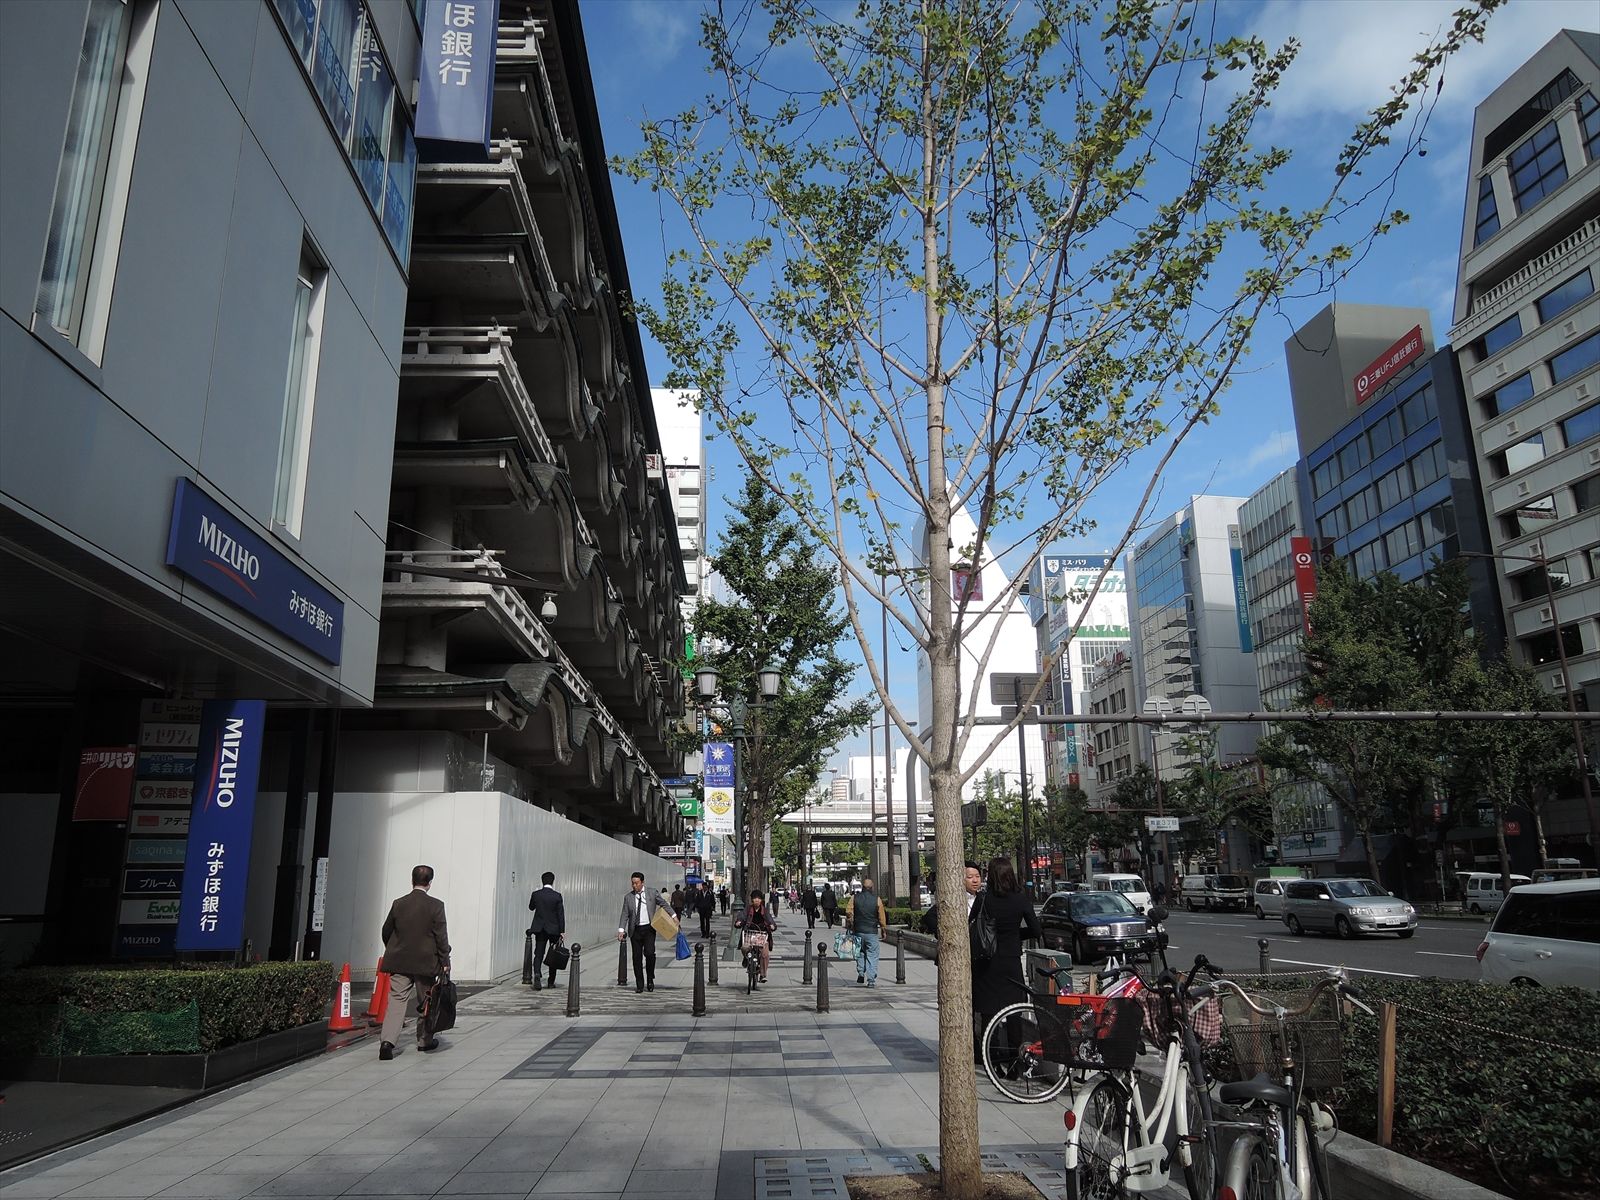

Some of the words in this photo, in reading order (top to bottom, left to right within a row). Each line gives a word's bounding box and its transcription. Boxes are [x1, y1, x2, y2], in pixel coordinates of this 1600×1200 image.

[198, 514, 260, 581] MIZUHO
[289, 589, 333, 638] みずほ銀行
[216, 717, 244, 809] MIZUHO
[200, 841, 225, 932] みずほ銀行
[122, 936, 161, 945] MIZUHO
